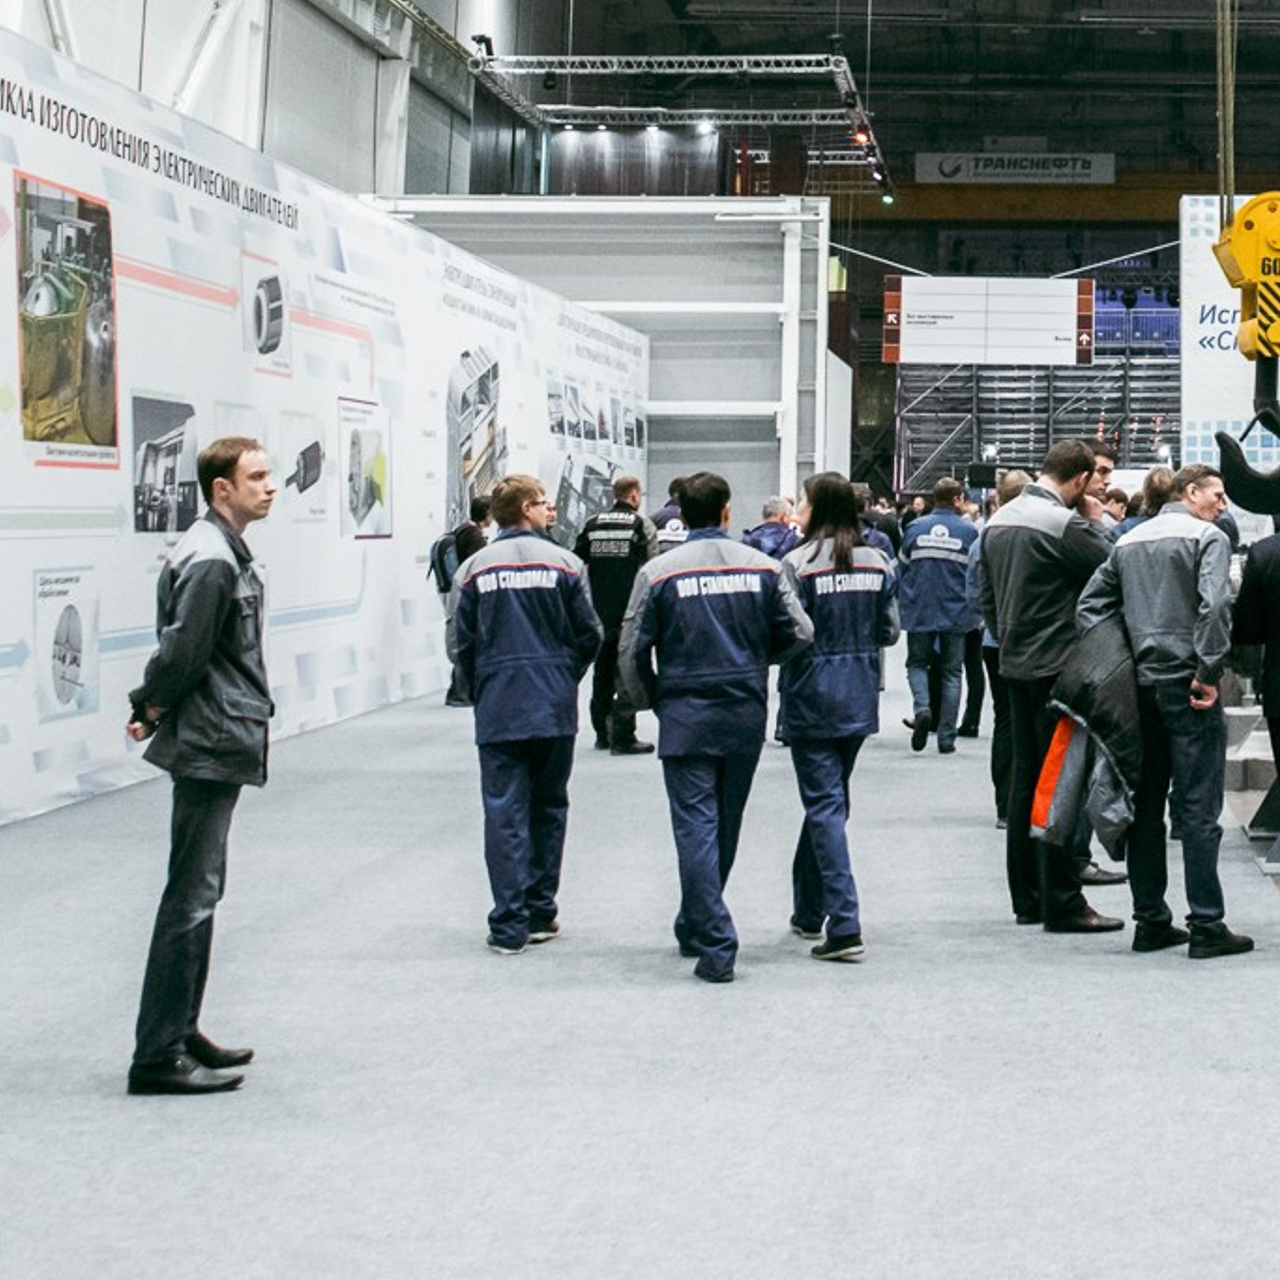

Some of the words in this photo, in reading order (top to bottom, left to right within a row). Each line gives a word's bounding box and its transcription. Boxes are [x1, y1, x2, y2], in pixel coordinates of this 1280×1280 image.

[40, 95, 150, 169] ИЗГОТОВЛЕНИЯ
[153, 144, 240, 207] ЭЛЕКТРИЧЕСКИХ
[242, 184, 298, 230] ДВИГАТЕЛЕЙ
[973, 157, 1092, 170] ТРАНСНЕФТЬ
